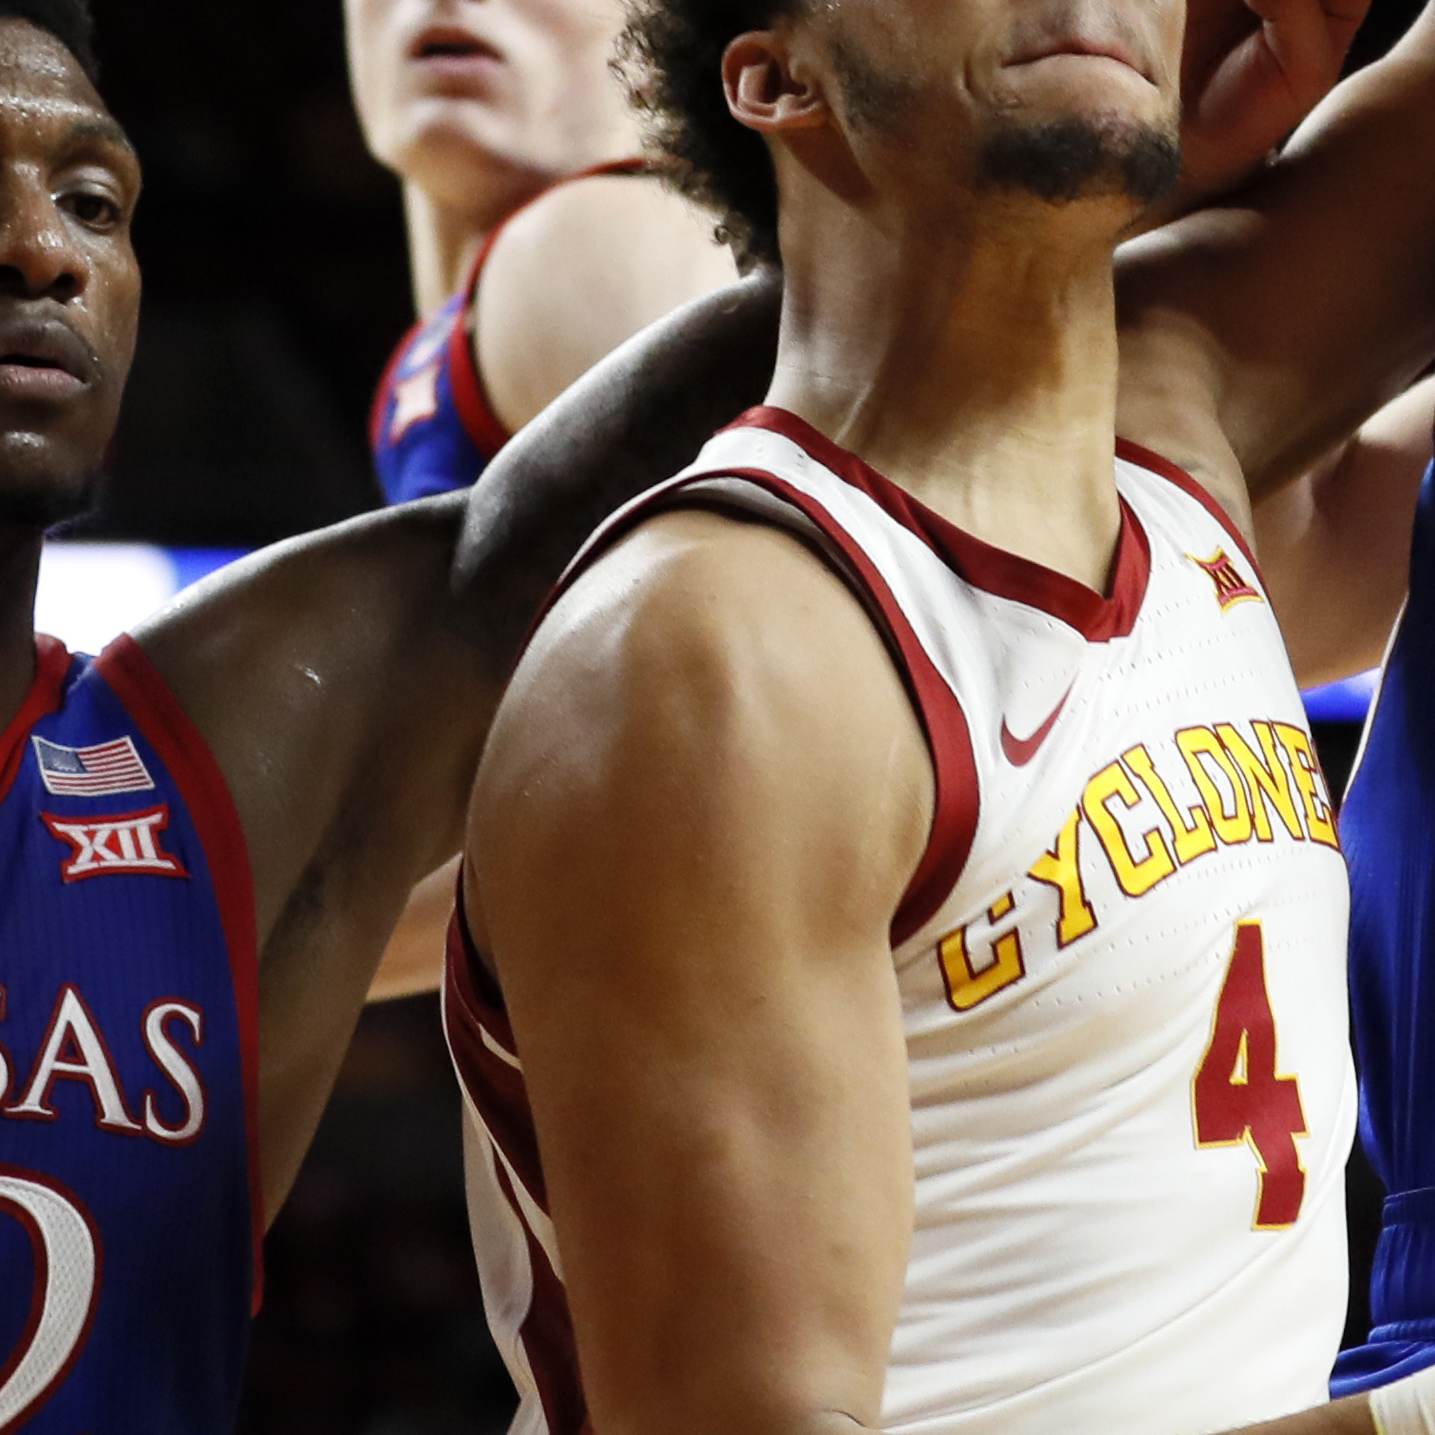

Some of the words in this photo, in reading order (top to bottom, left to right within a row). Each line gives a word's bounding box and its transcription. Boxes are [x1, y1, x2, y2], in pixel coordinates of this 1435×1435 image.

[46, 808, 183, 879] XII
[937, 718, 1341, 1012] CYCLONE
[1193, 918, 1311, 1232] 4
